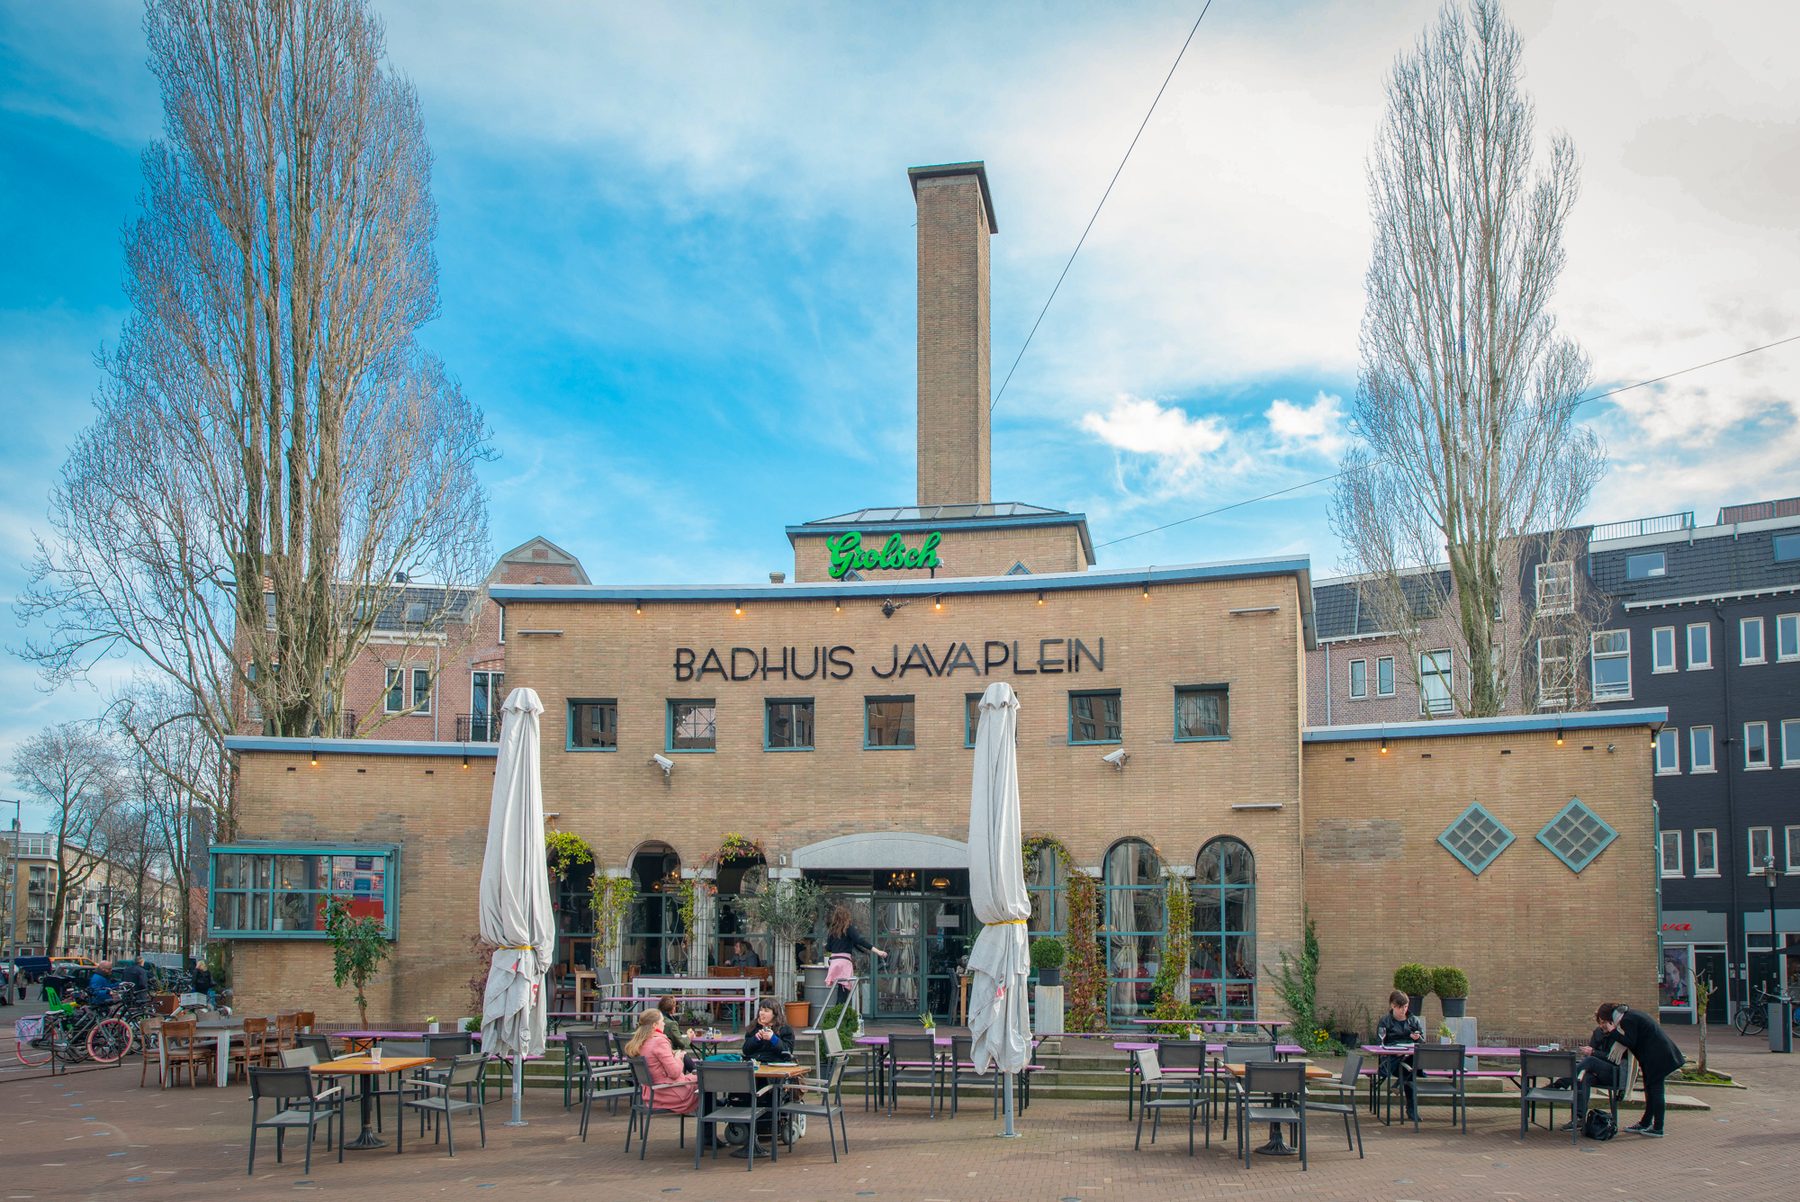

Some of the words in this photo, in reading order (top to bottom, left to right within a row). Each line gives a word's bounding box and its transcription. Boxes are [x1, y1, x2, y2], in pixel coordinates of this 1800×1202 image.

[826, 531, 941, 578] Grolsch
[673, 645, 855, 682] BADHUIS
[871, 636, 1104, 679] JAVAPLEIN
